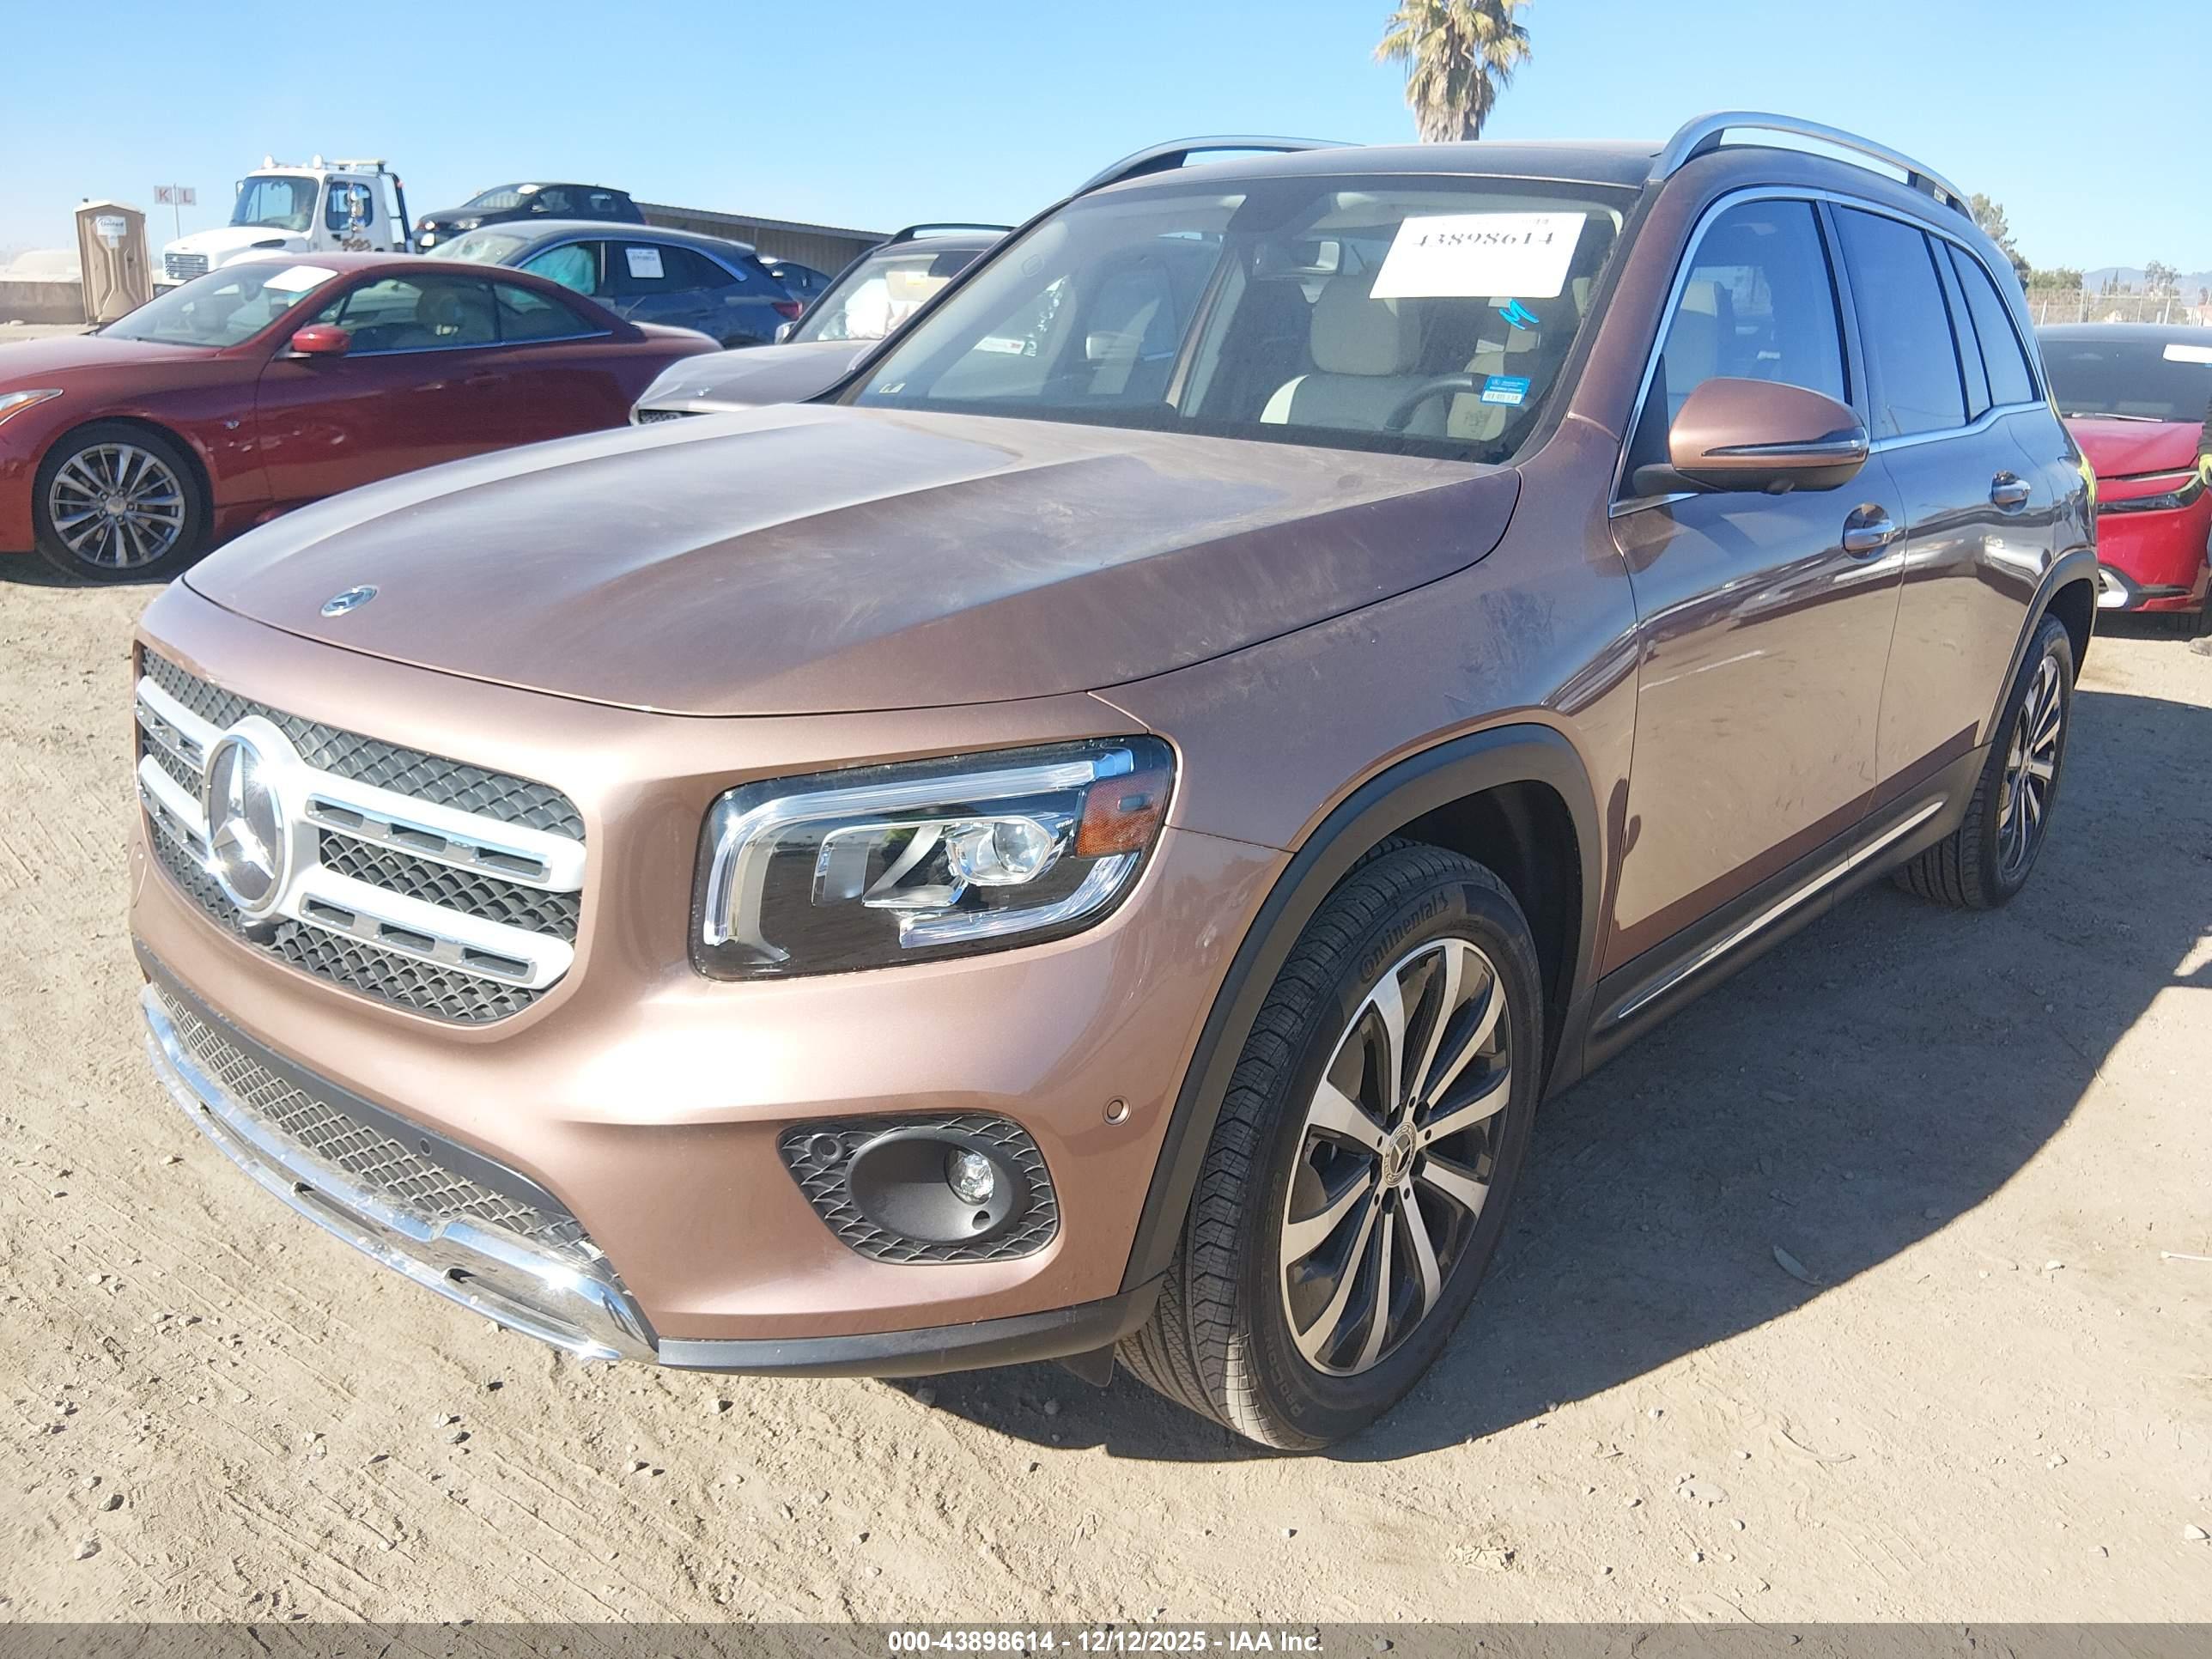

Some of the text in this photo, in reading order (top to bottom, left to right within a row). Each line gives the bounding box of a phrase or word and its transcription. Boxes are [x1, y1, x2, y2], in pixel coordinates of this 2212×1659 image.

[159, 189, 192, 204] K L
[1361, 894, 1440, 982] Continental
